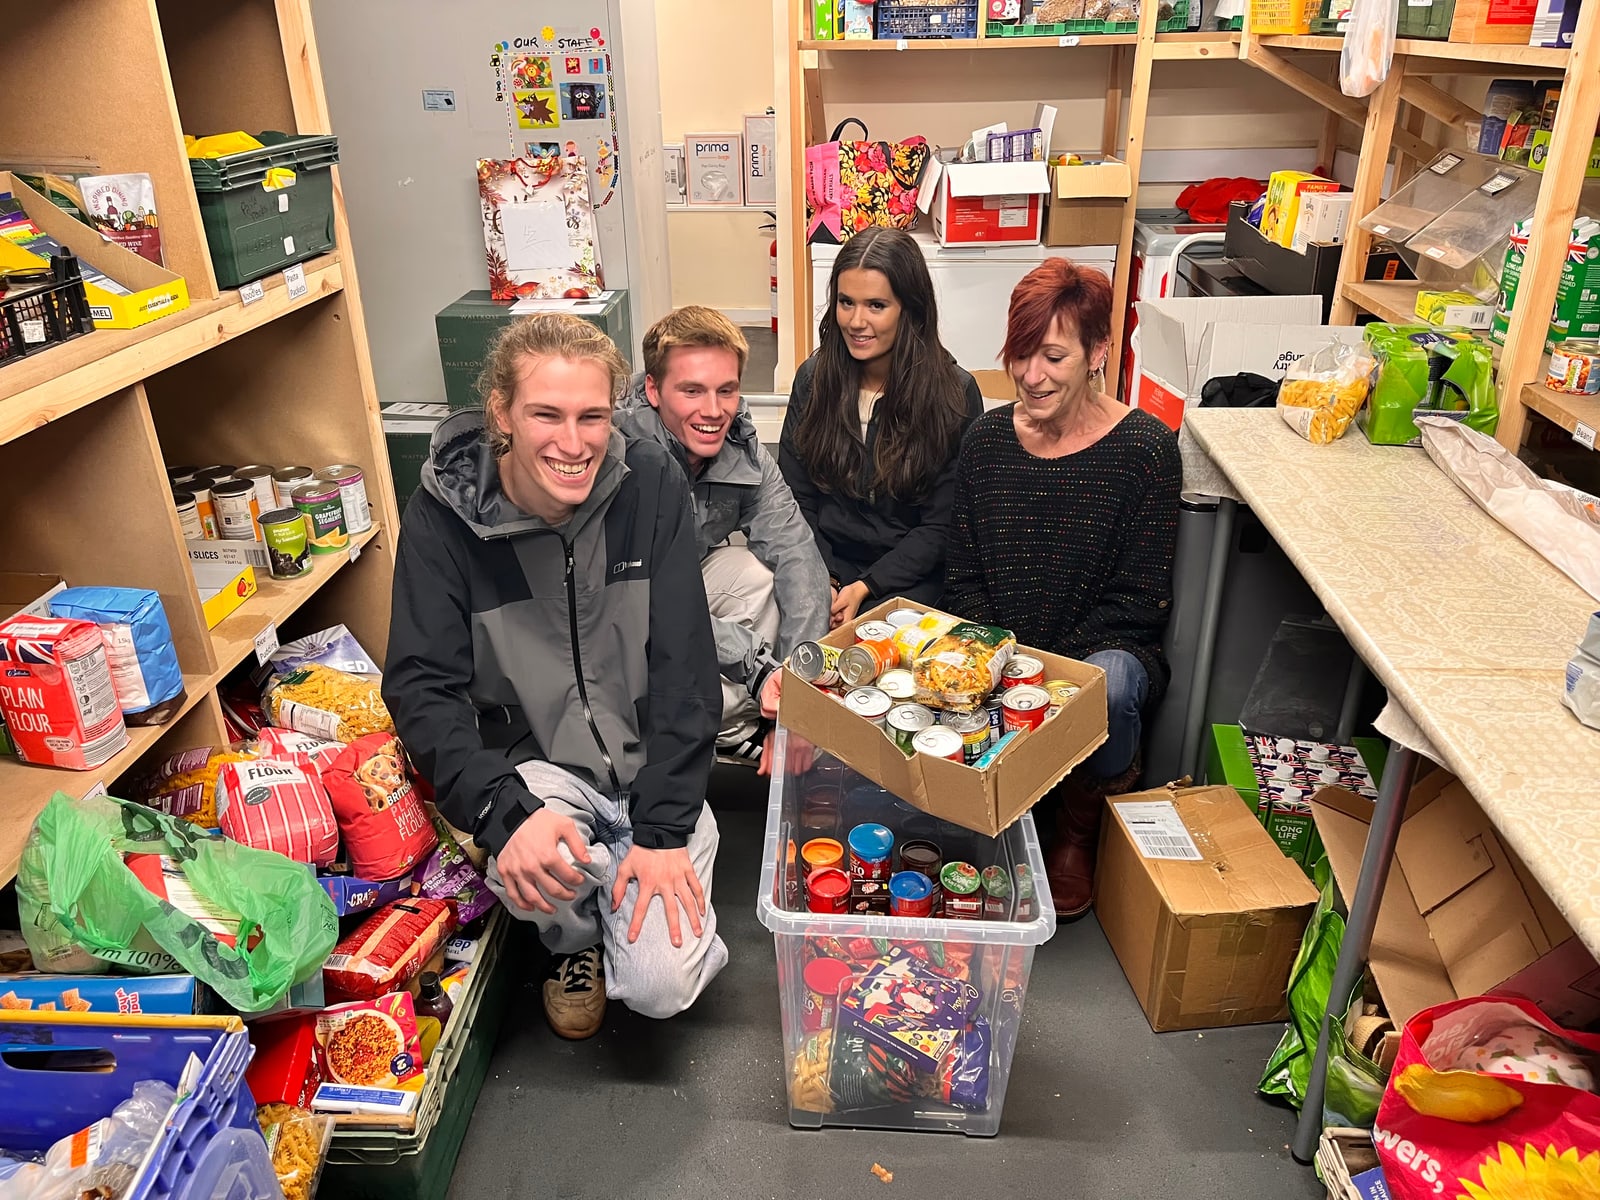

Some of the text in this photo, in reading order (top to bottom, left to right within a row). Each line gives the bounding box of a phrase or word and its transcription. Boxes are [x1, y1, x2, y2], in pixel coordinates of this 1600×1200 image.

[513, 37, 594, 49] OUR STAFF
[696, 143, 729, 156] prima
[751, 144, 763, 177] prima
[92, 185, 128, 211] INSPIRED DINING
[243, 288, 262, 300] Noodles
[1575, 427, 1593, 443] Beans
[194, 551, 219, 560] SLICES
[1, 686, 45, 709] PLAIN
[8, 711, 53, 733] FLOUR
[296, 740, 334, 753] FLOU
[248, 767, 293, 780] FLOUR
[386, 779, 412, 806] BRITISH
[391, 790, 416, 817] PLAIN
[394, 800, 421, 828] WHITE
[399, 812, 427, 841] FLOUR
[1275, 825, 1303, 834] LONG
[1278, 832, 1298, 840] LIFE
[92, 947, 182, 970] I'm 100%
